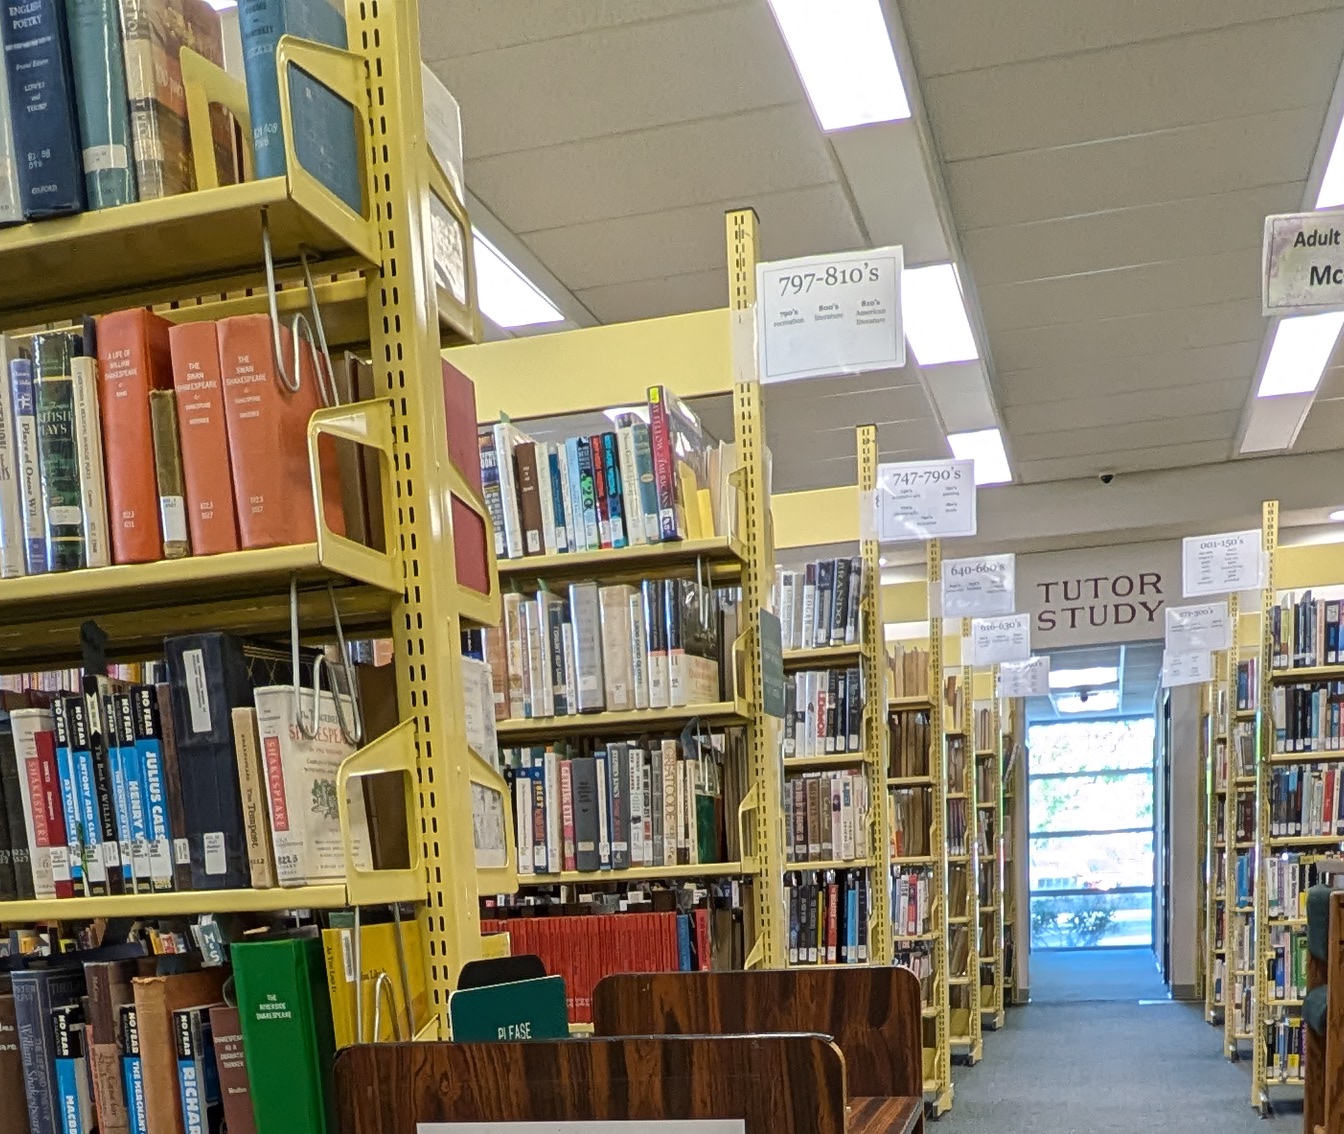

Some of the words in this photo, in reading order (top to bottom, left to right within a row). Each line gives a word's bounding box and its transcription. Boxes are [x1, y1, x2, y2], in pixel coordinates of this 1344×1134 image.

[9, 1, 42, 16] ENGLISH
[13, 15, 42, 29] POETRY
[1294, 229, 1341, 248] Adult
[779, 263, 879, 297] 797-810's
[818, 303, 839, 312] 800's
[861, 299, 880, 307] 810's
[780, 309, 798, 318] 790's
[814, 313, 843, 321] literature
[856, 308, 886, 316] American
[773, 317, 805, 327] recreation
[856, 317, 886, 325] literature
[188, 362, 201, 371] THE
[238, 355, 251, 363] THE
[105, 368, 138, 380] SHAKESPEARE
[226, 374, 267, 386] SHAKESPEARE
[177, 381, 218, 391] SHAKESPEARE
[21, 423, 31, 455] Plays
[893, 467, 961, 486] 747-790's
[1200, 536, 1244, 549] 001-150's
[951, 562, 1005, 576] 640-660's
[1037, 573, 1163, 603] TUTOR
[1037, 600, 1164, 632] STUDY
[121, 698, 129, 714] NO
[140, 690, 150, 707] NO
[55, 700, 62, 714] NO
[75, 706, 82, 721] NO
[107, 704, 113, 716] NO
[123, 715, 132, 741] FEAR
[143, 708, 153, 735] FEAR
[57, 716, 65, 743] FEAR
[77, 722, 85, 745] FEAR
[79, 756, 90, 793] ANTONY
[146, 752, 161, 802] JULIUS
[267, 738, 285, 828] SHAKESPEARE
[26, 759, 48, 846] SHAKESPEARE
[129, 781, 142, 824] HENRY
[248, 803, 258, 848] Tempest
[259, 1002, 286, 1011] RIVERSIDE
[58, 1014, 65, 1029] NO
[128, 1012, 136, 1028] NO
[180, 1014, 188, 1029] NO
[256, 1011, 292, 1020] SHAKESPEARE
[59, 1030, 68, 1056] FEAR
[130, 1029, 139, 1054] FEAR
[182, 1031, 190, 1056] FEAR
[134, 1077, 146, 1130] MERCHANT
